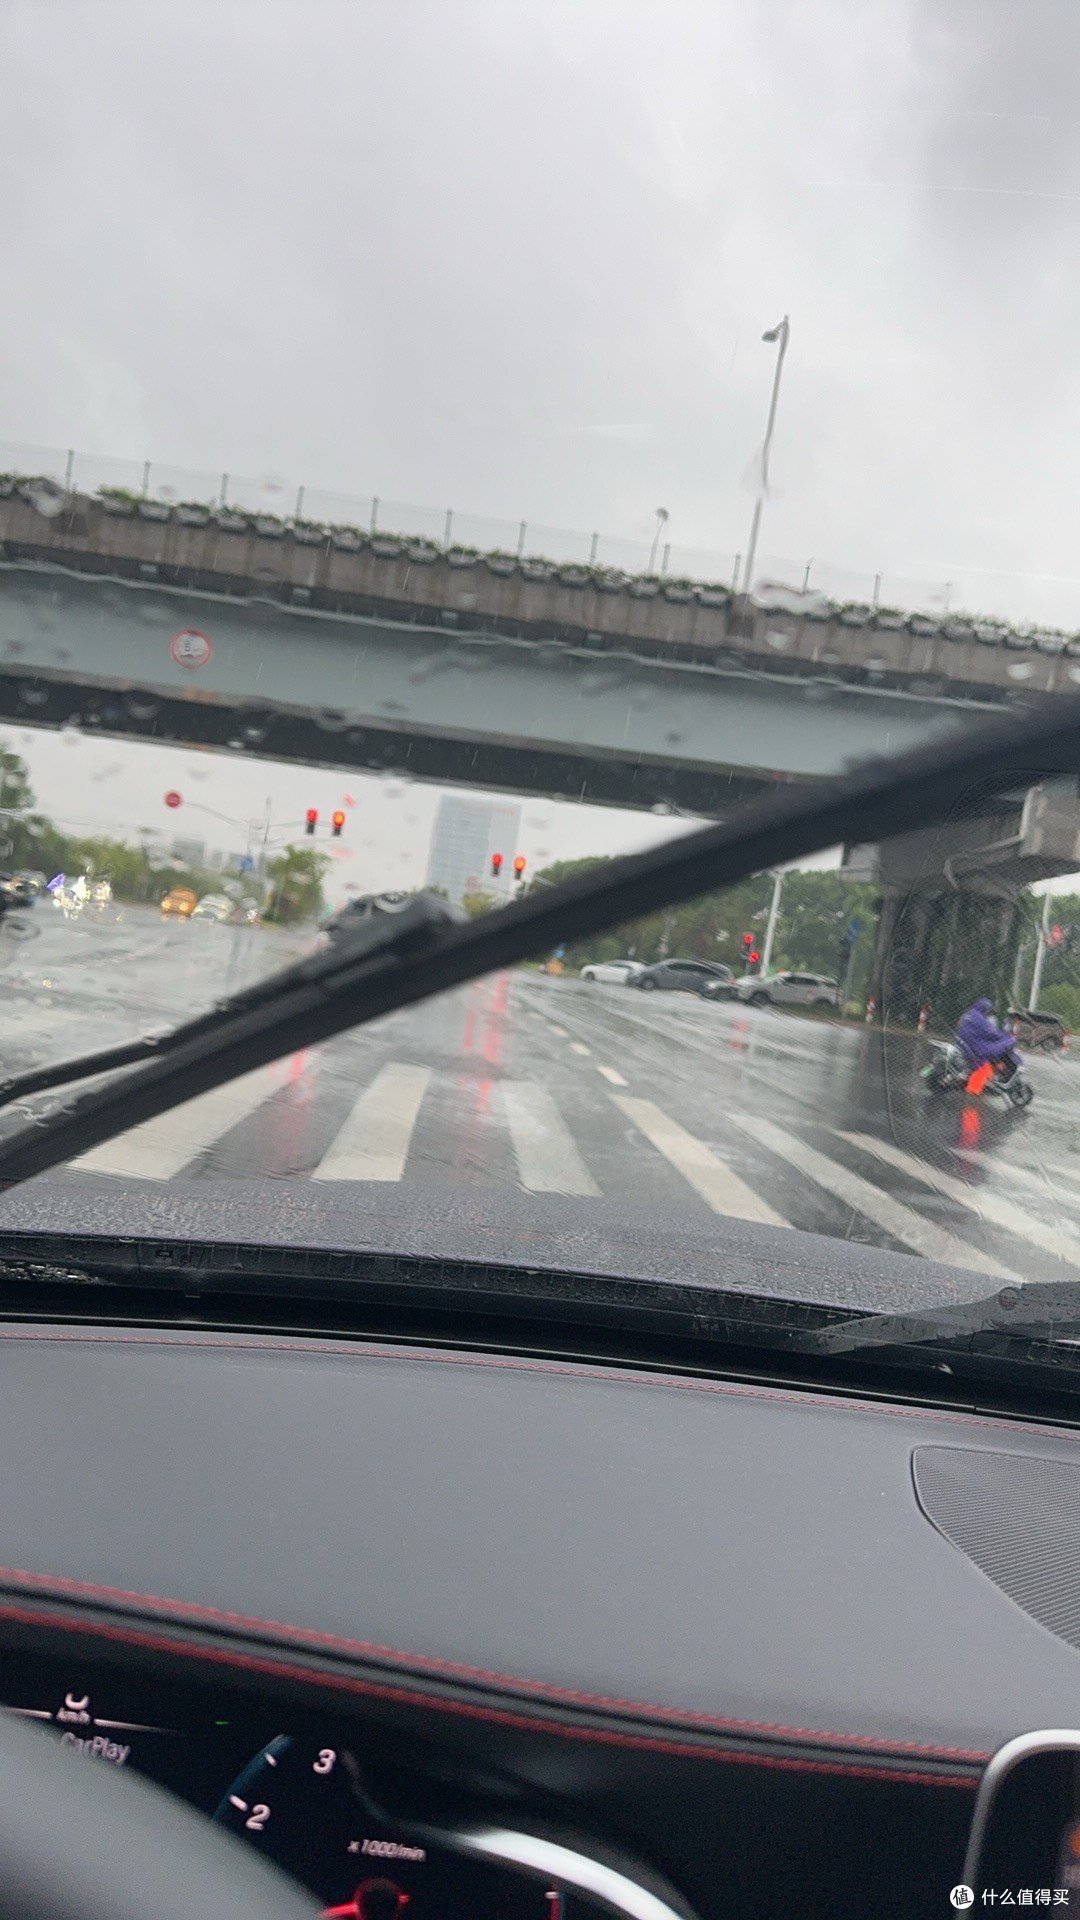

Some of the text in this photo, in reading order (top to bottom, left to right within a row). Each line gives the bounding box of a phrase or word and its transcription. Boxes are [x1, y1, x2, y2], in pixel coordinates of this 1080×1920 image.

[61, 1732, 130, 1765] CarPlay
[313, 1749, 336, 1774] 3
[245, 1804, 270, 1830] 2
